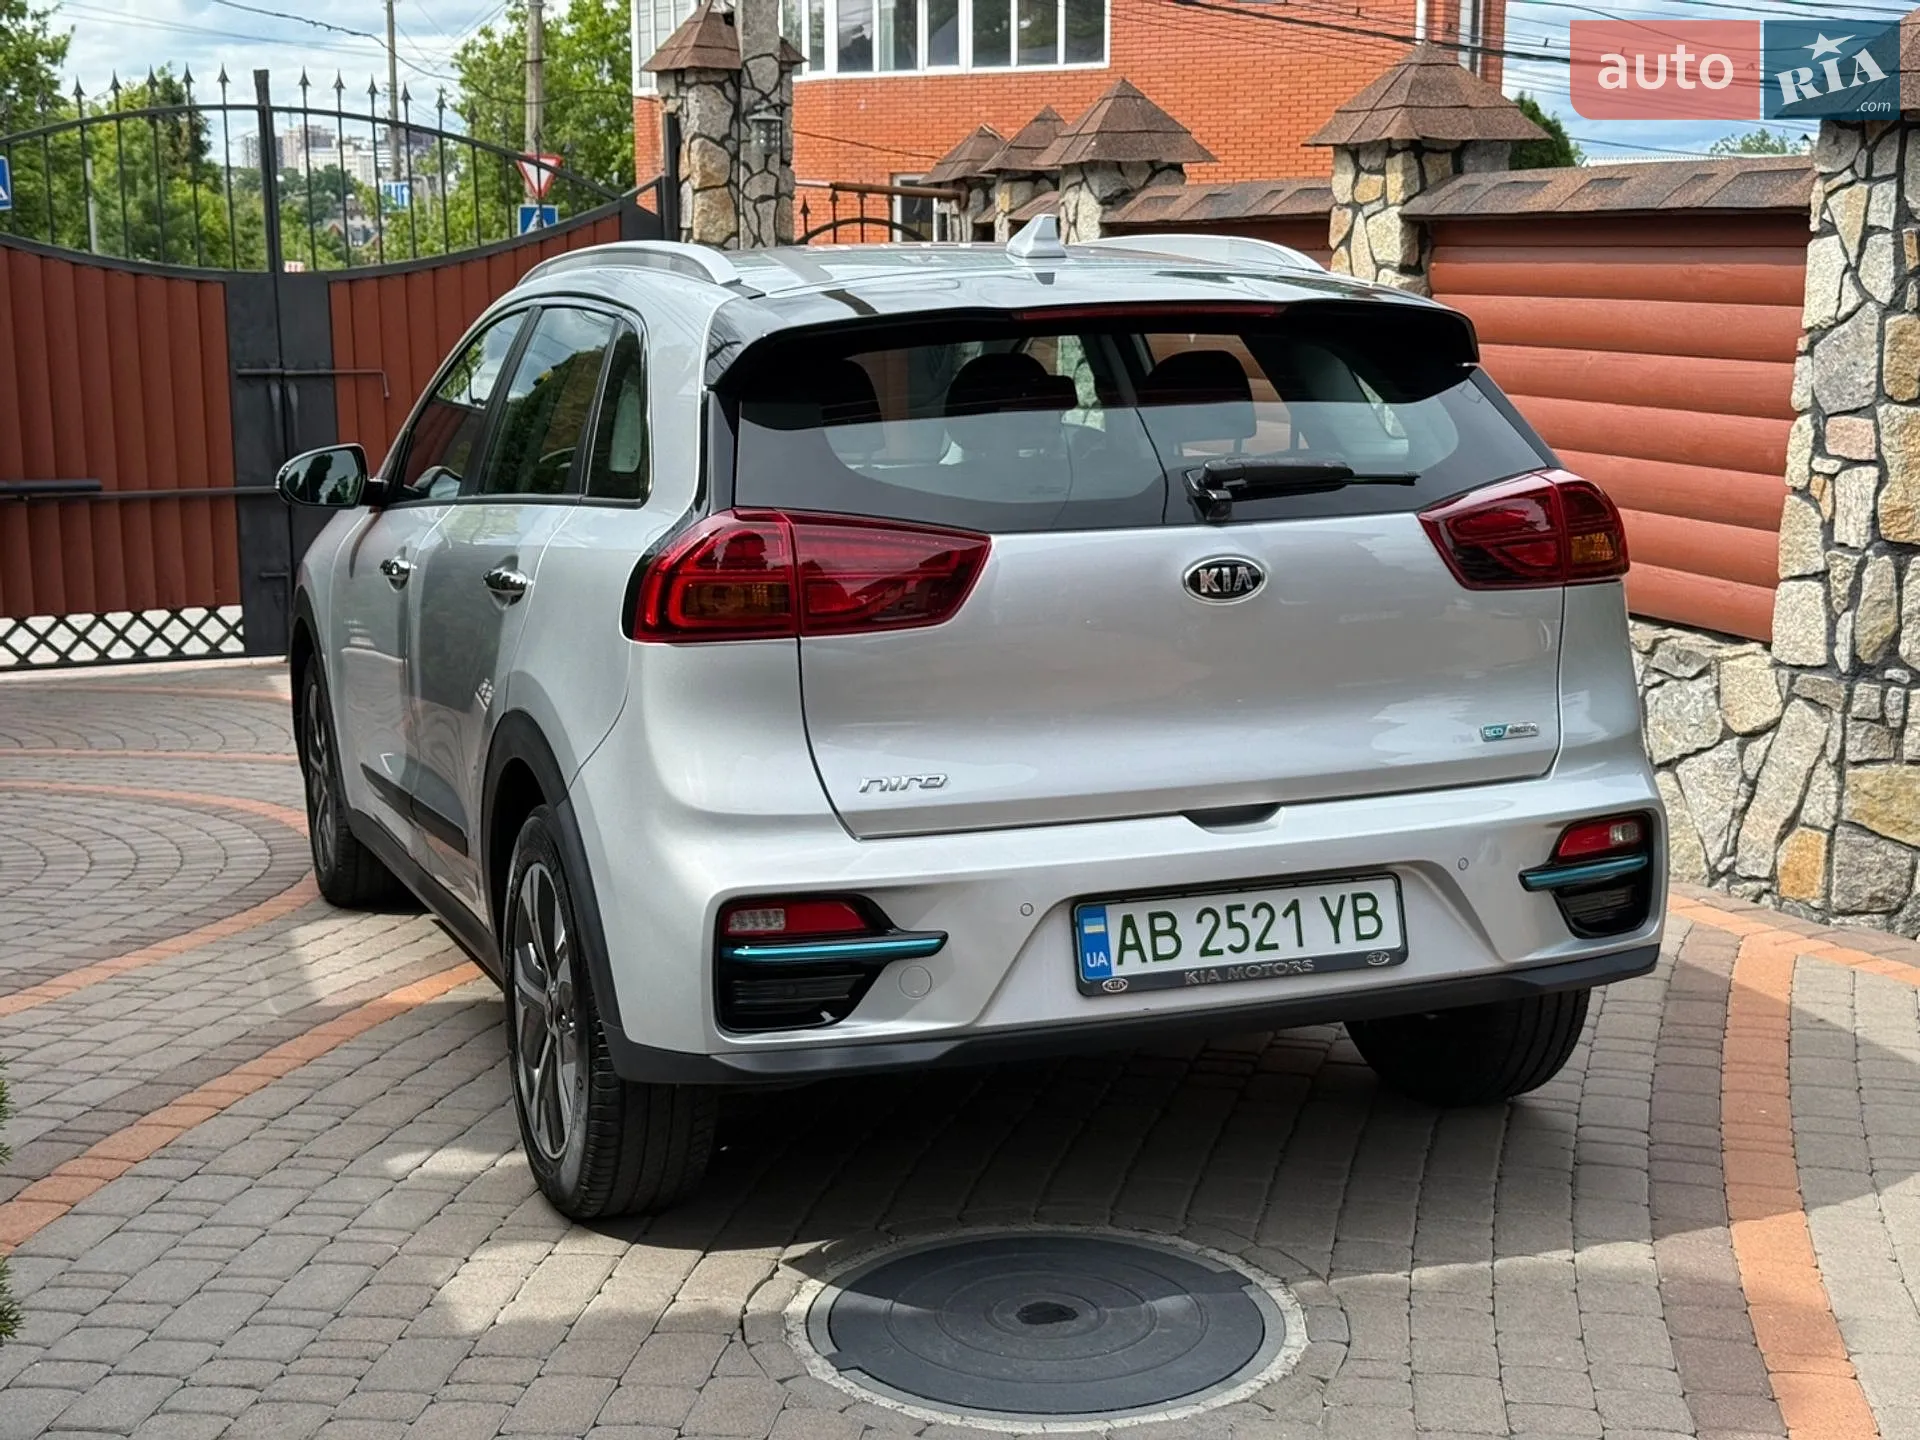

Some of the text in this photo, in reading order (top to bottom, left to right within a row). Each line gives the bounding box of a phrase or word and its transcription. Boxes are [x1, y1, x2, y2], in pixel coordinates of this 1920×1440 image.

[1198, 566, 1254, 593] KIA
[1117, 892, 1383, 965] AB 2521 YB
[1086, 951, 1109, 968] UA
[1184, 959, 1315, 985] KIA MOTORS
